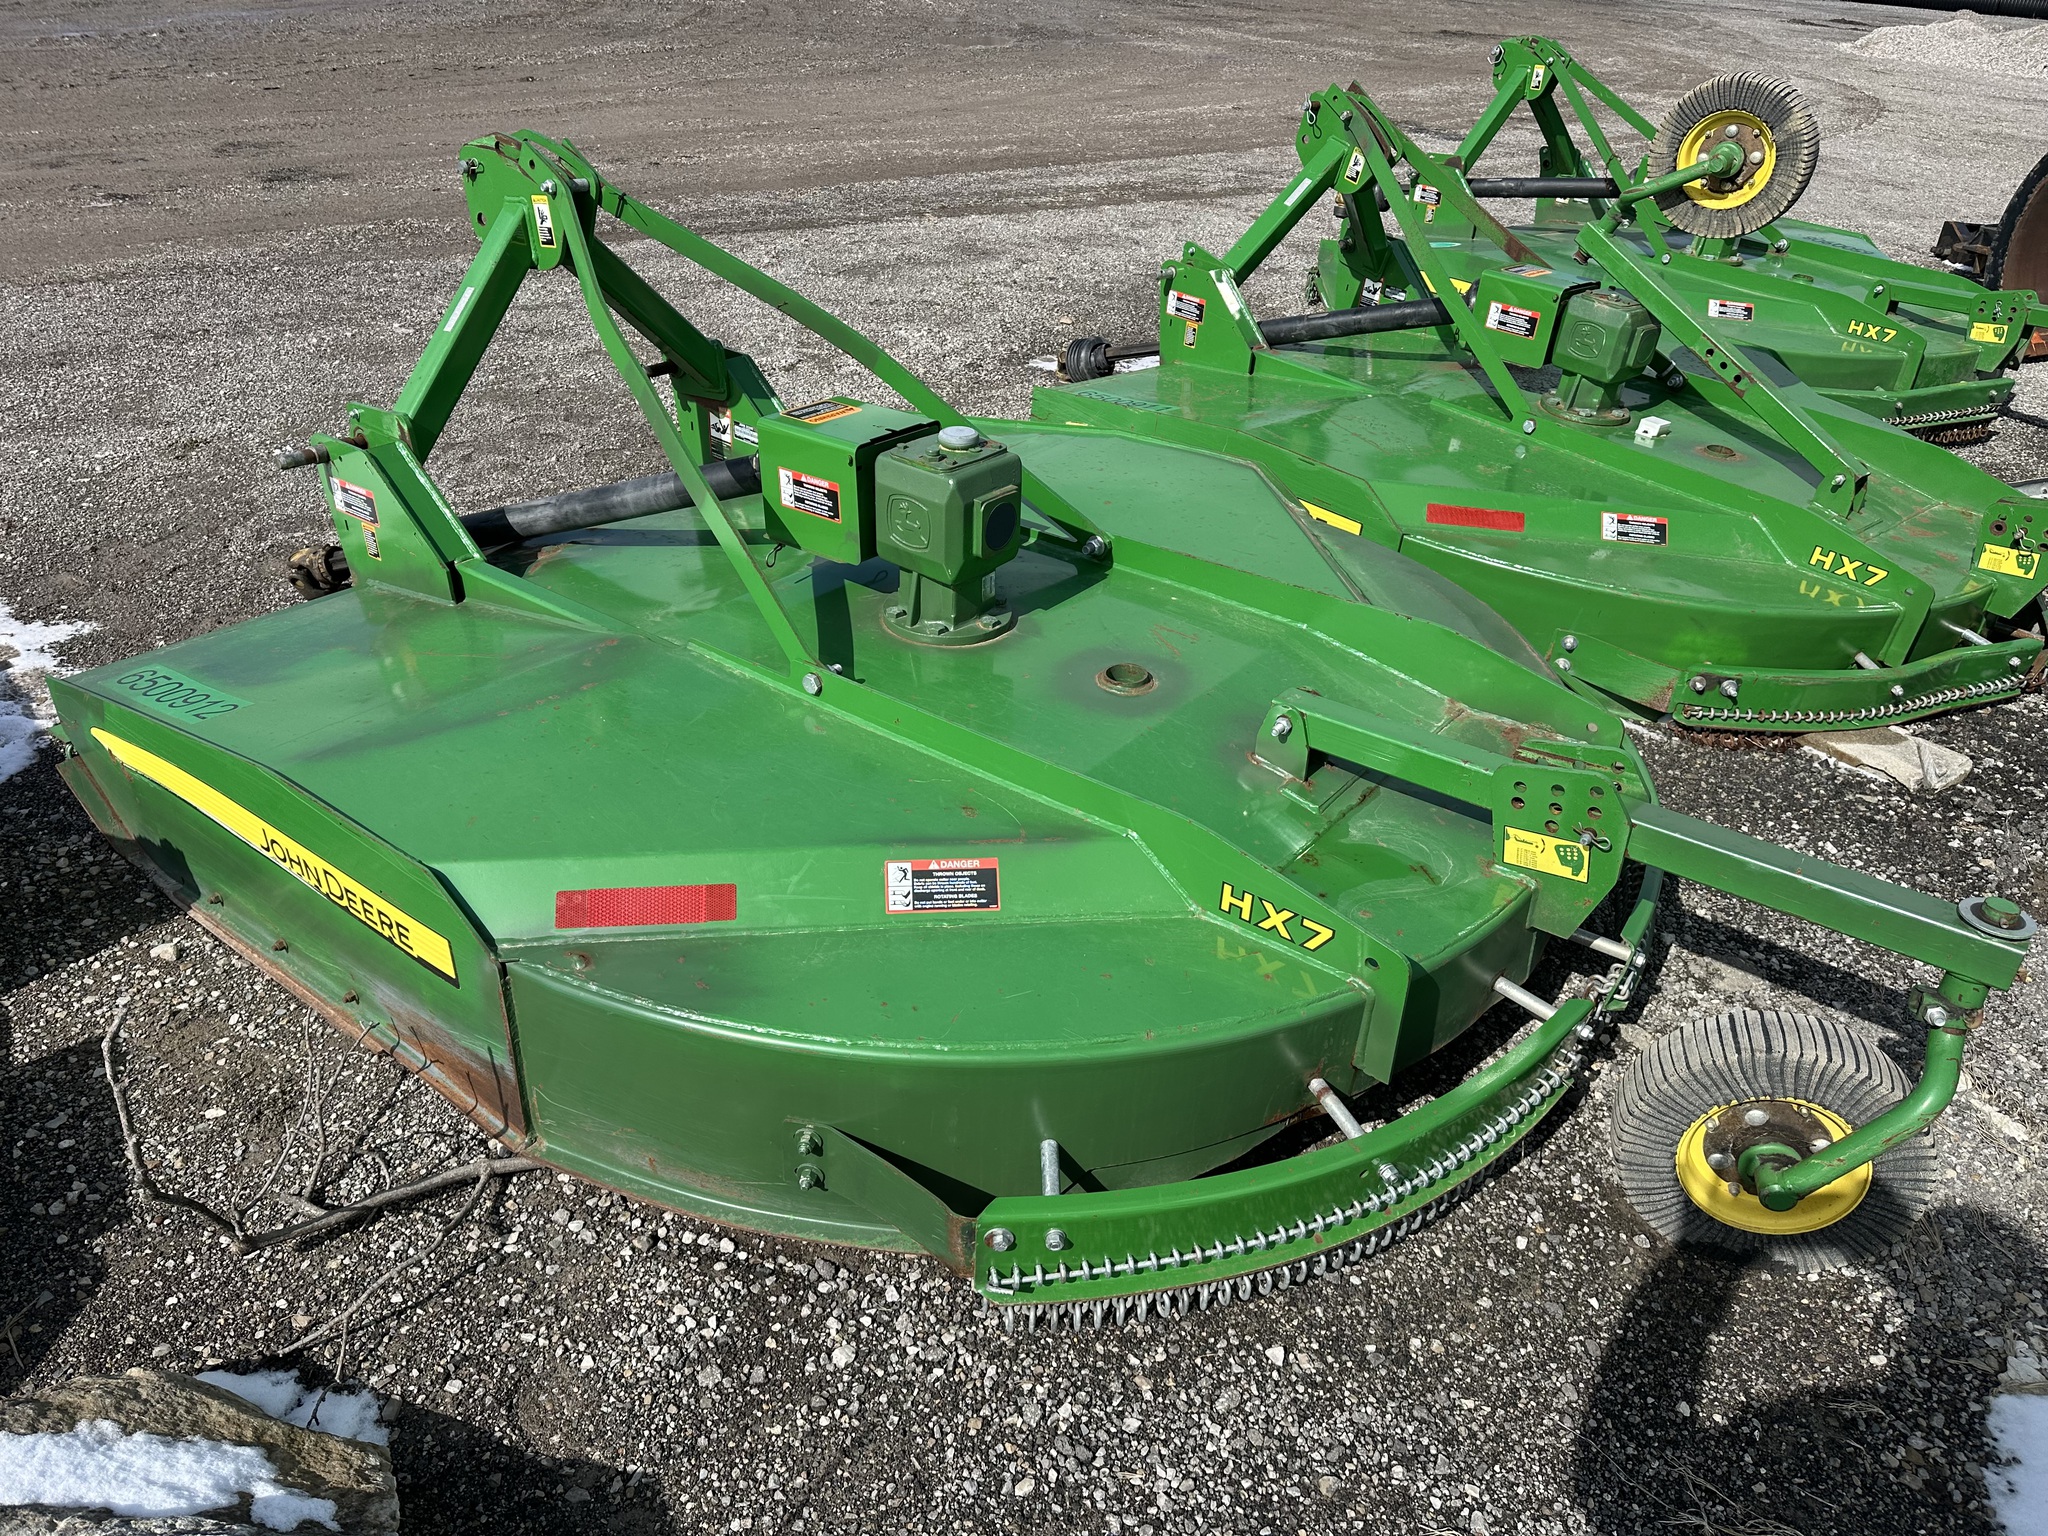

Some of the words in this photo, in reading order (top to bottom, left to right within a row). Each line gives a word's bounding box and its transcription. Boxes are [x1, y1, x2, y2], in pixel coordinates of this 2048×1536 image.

[1847, 319, 1898, 343] HX7
[806, 476, 830, 489] DANGER
[1633, 515, 1658, 523] DANGER
[1808, 545, 1889, 587] HX7
[116, 669, 239, 720] 6500912
[940, 860, 981, 869] DANGER
[260, 828, 323, 889] JOHN
[323, 868, 414, 951] DEERE
[1219, 881, 1336, 952] HX7
